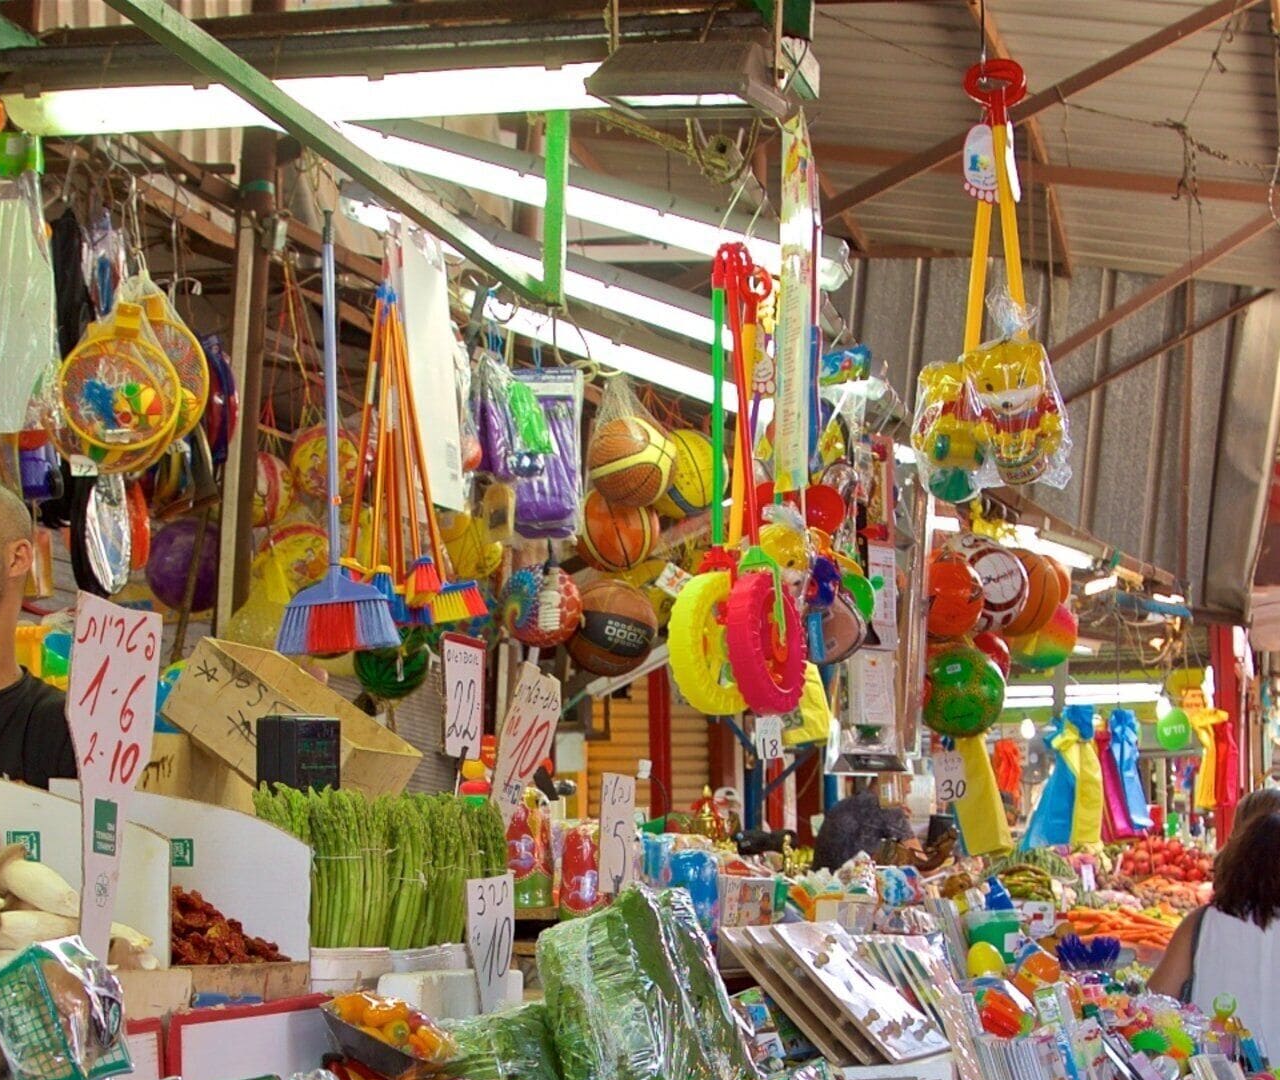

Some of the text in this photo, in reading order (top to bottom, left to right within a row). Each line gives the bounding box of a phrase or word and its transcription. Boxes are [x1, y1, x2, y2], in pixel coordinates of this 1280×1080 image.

[762, 737, 779, 758] 18
[940, 779, 966, 800] 30
[482, 916, 512, 987] 10
